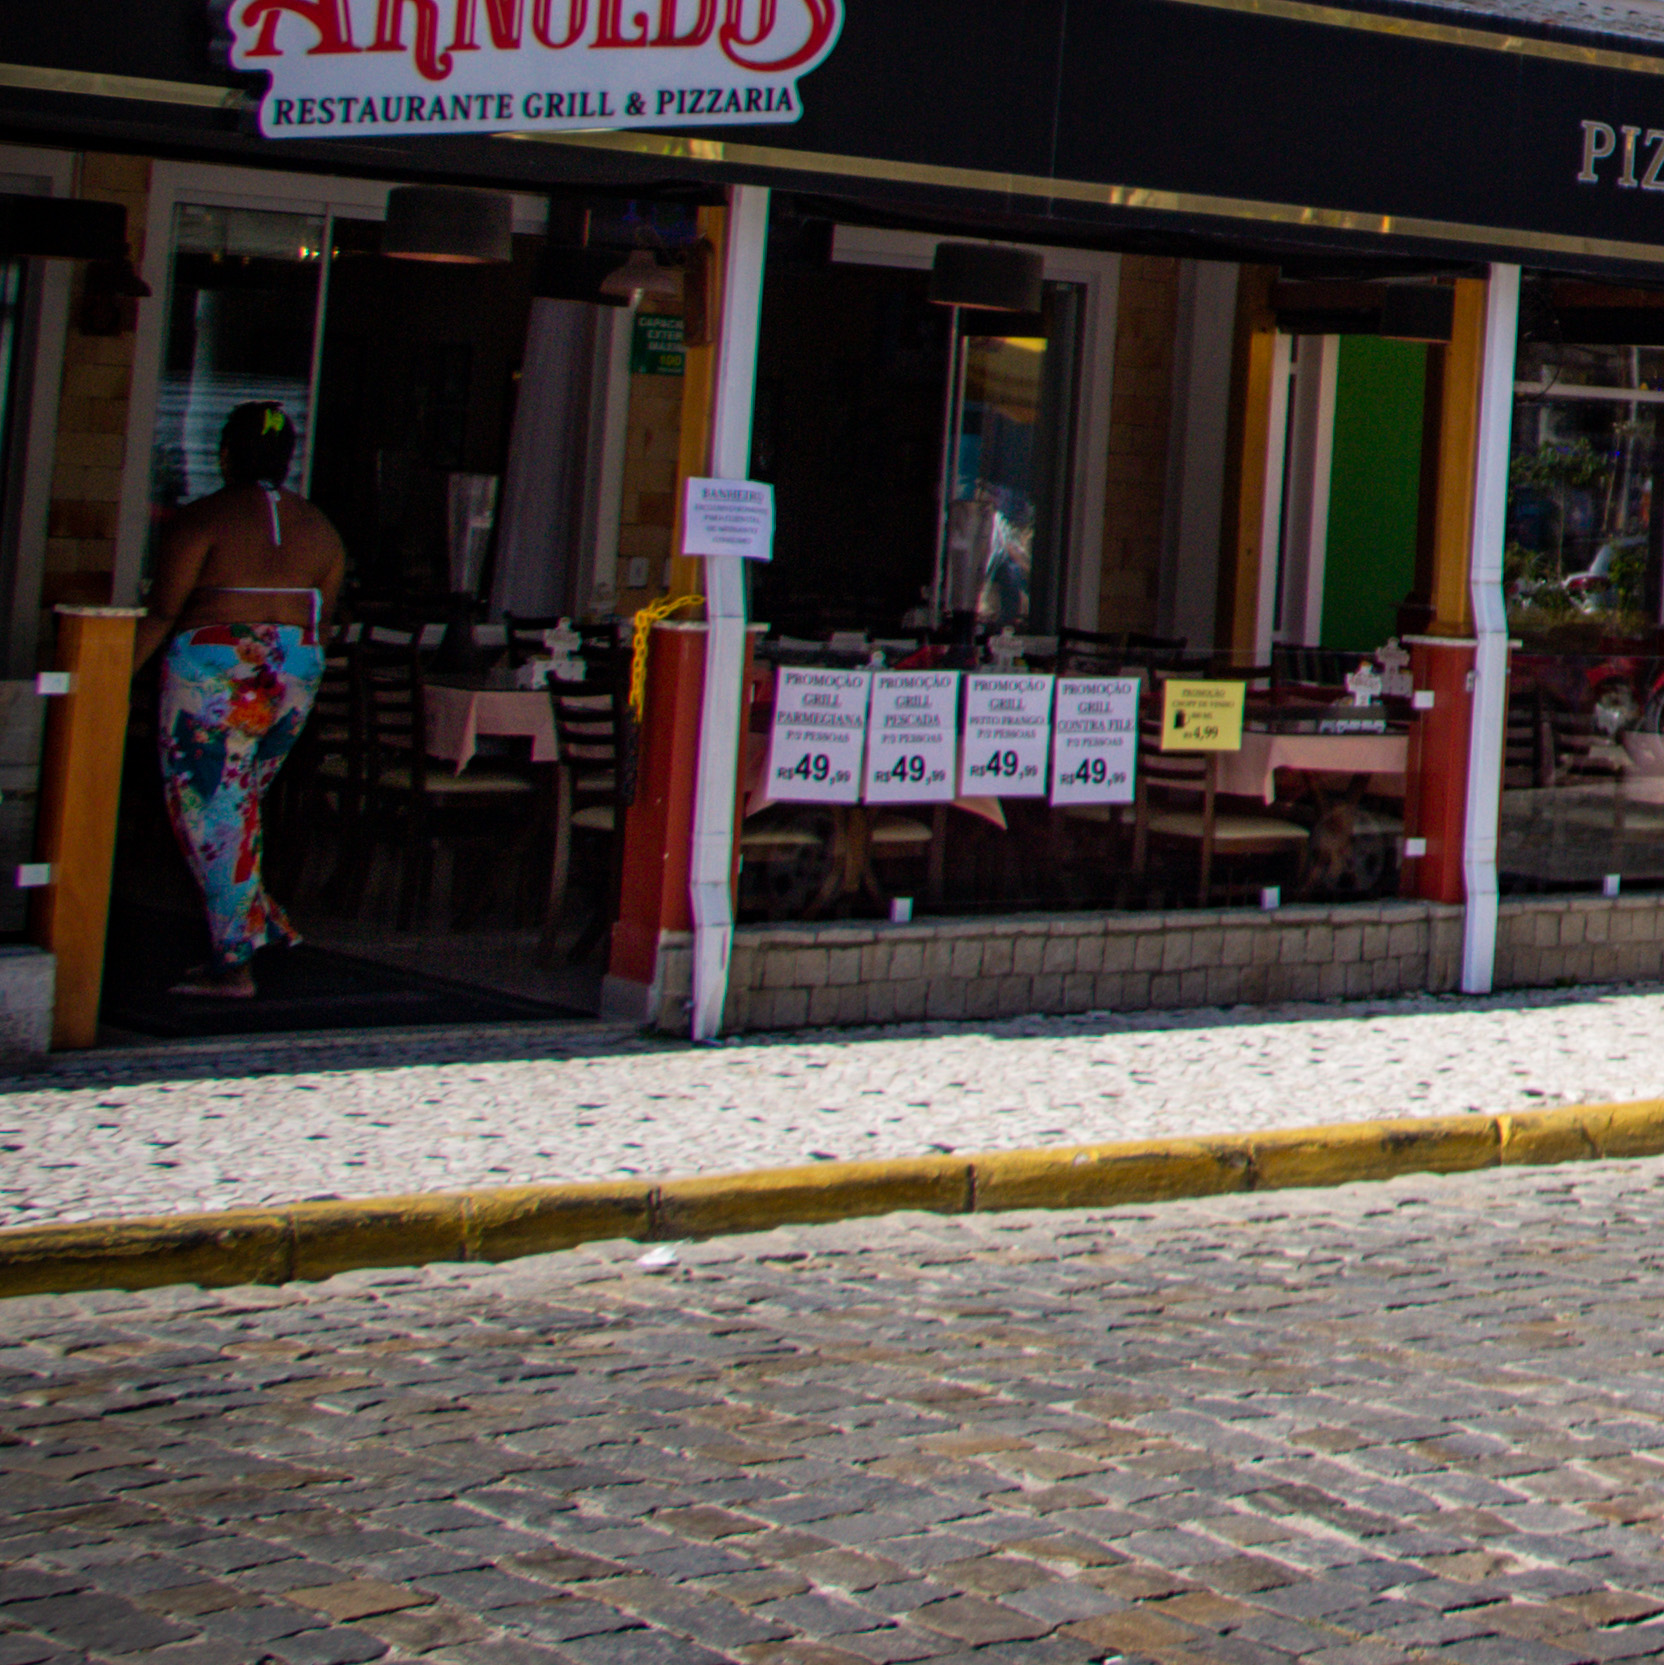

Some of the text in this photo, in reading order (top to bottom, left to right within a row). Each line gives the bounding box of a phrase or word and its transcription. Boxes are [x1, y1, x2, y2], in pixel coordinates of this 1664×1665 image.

[272, 84, 793, 127] RESTAURANTE GRILL & PIZZARIA
[785, 672, 864, 691] PROMOÇÃO
[879, 674, 952, 691] PROMOÇÃO
[973, 679, 1046, 694] PROMOÇÃO
[1062, 682, 1132, 697] PROMOÇÃO
[802, 693, 842, 709] GRILL
[894, 695, 933, 709] GRILL
[988, 698, 1027, 711] GRILL
[1077, 701, 1114, 715] GRILL
[776, 711, 862, 727] PARMEGIANA
[883, 713, 941, 728] PESCADA
[1057, 719, 1106, 733] CONTRA
